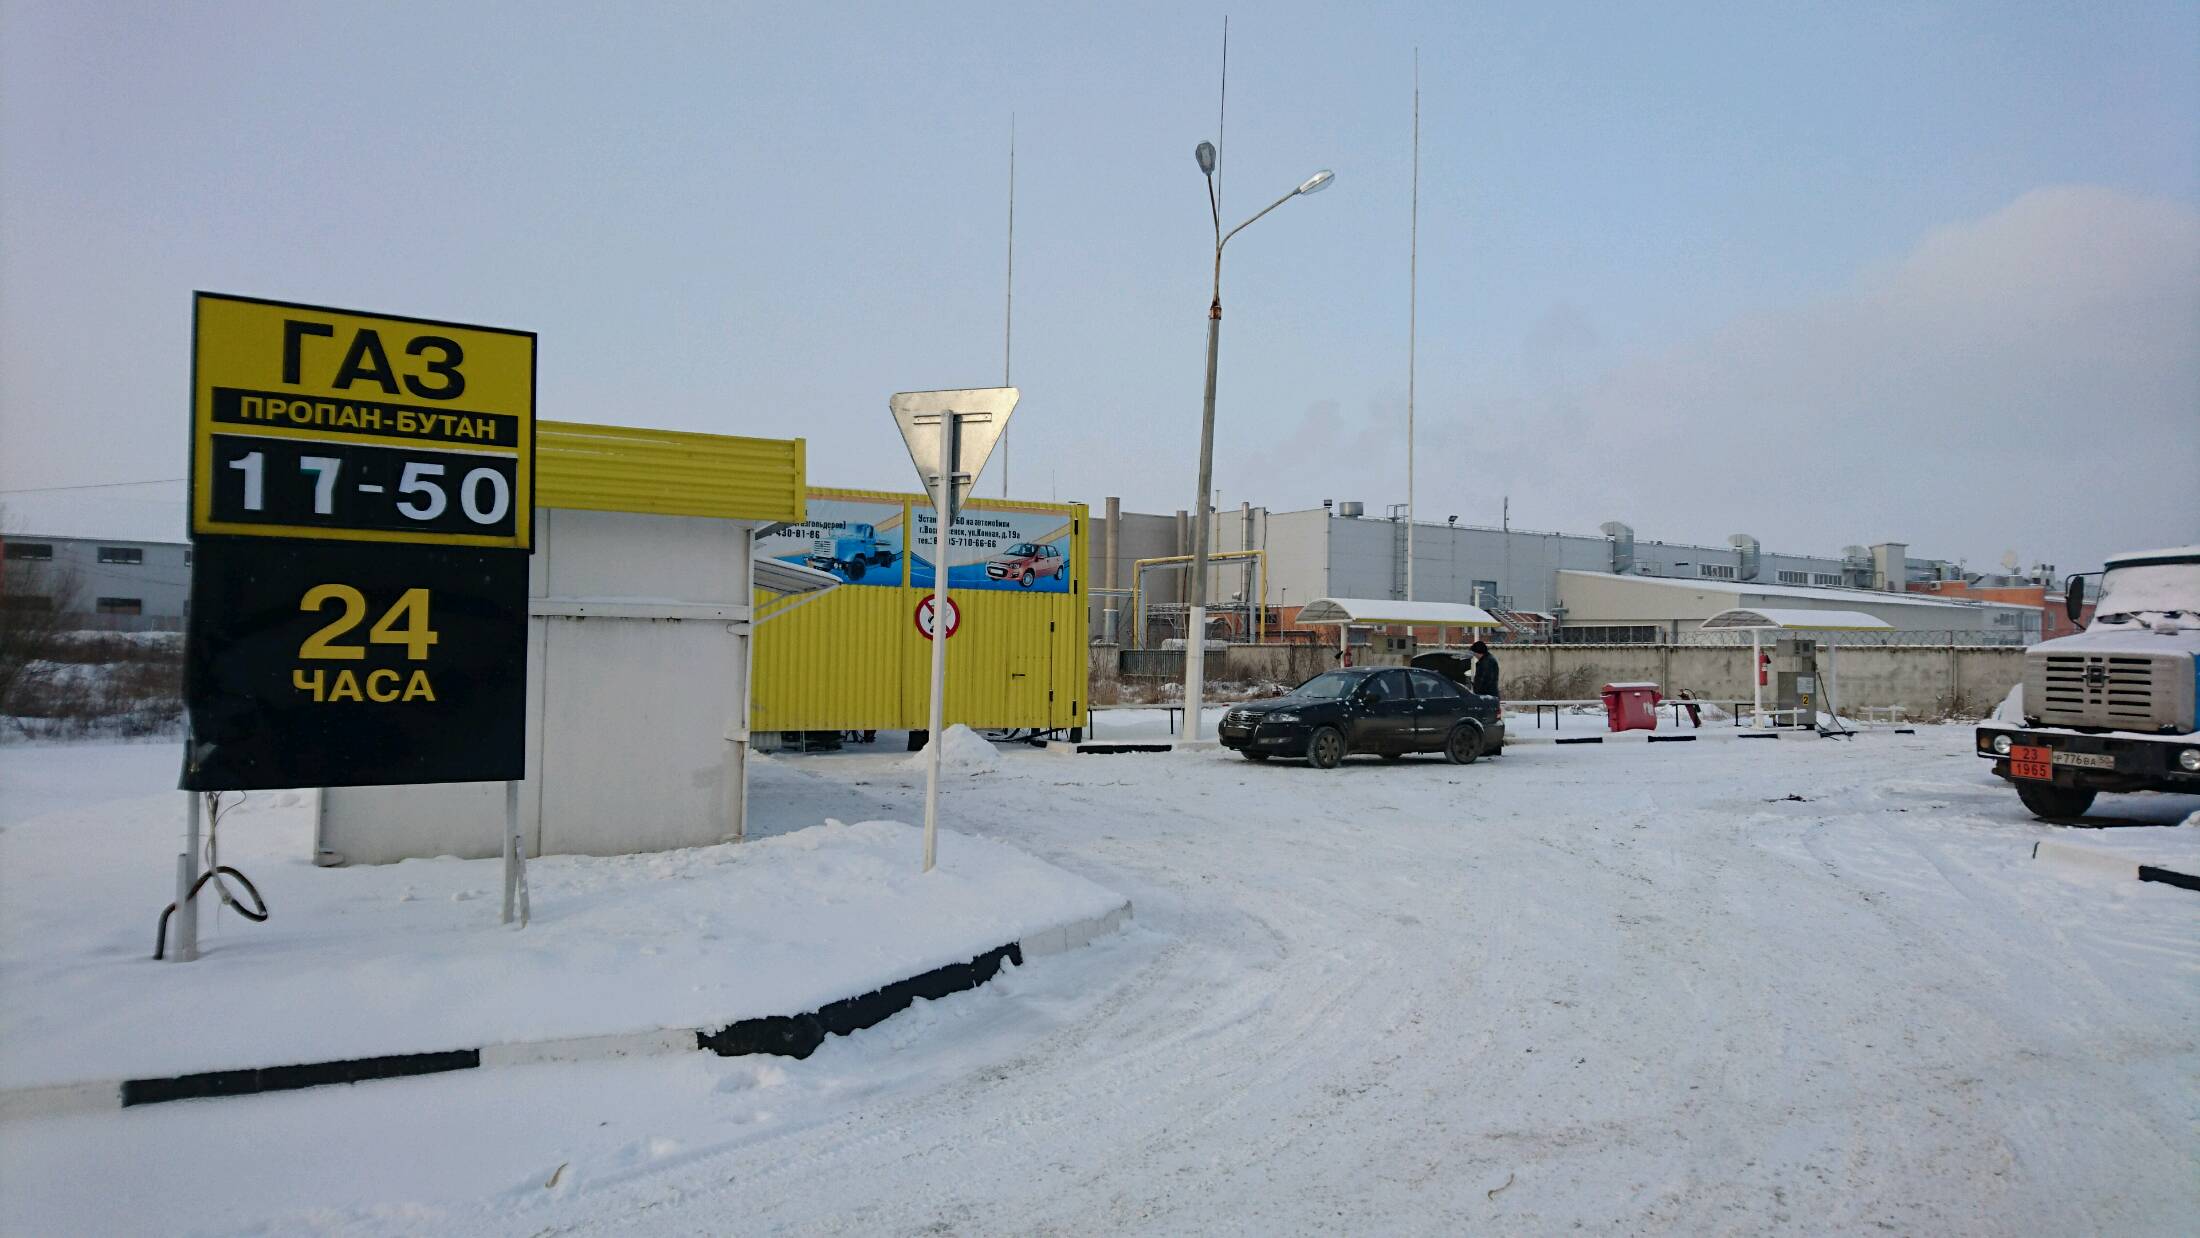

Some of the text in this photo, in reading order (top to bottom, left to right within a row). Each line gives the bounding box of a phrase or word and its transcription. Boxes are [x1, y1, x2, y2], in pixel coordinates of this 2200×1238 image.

[282, 319, 466, 400] ГАЗ
[240, 396, 496, 441] ПРОПАН-БУТАН
[229, 451, 510, 525] 17-50
[298, 583, 439, 660] 24
[292, 668, 437, 702] ЧАСА
[2017, 763, 2046, 777] 1965
[2023, 748, 2038, 760] 23
